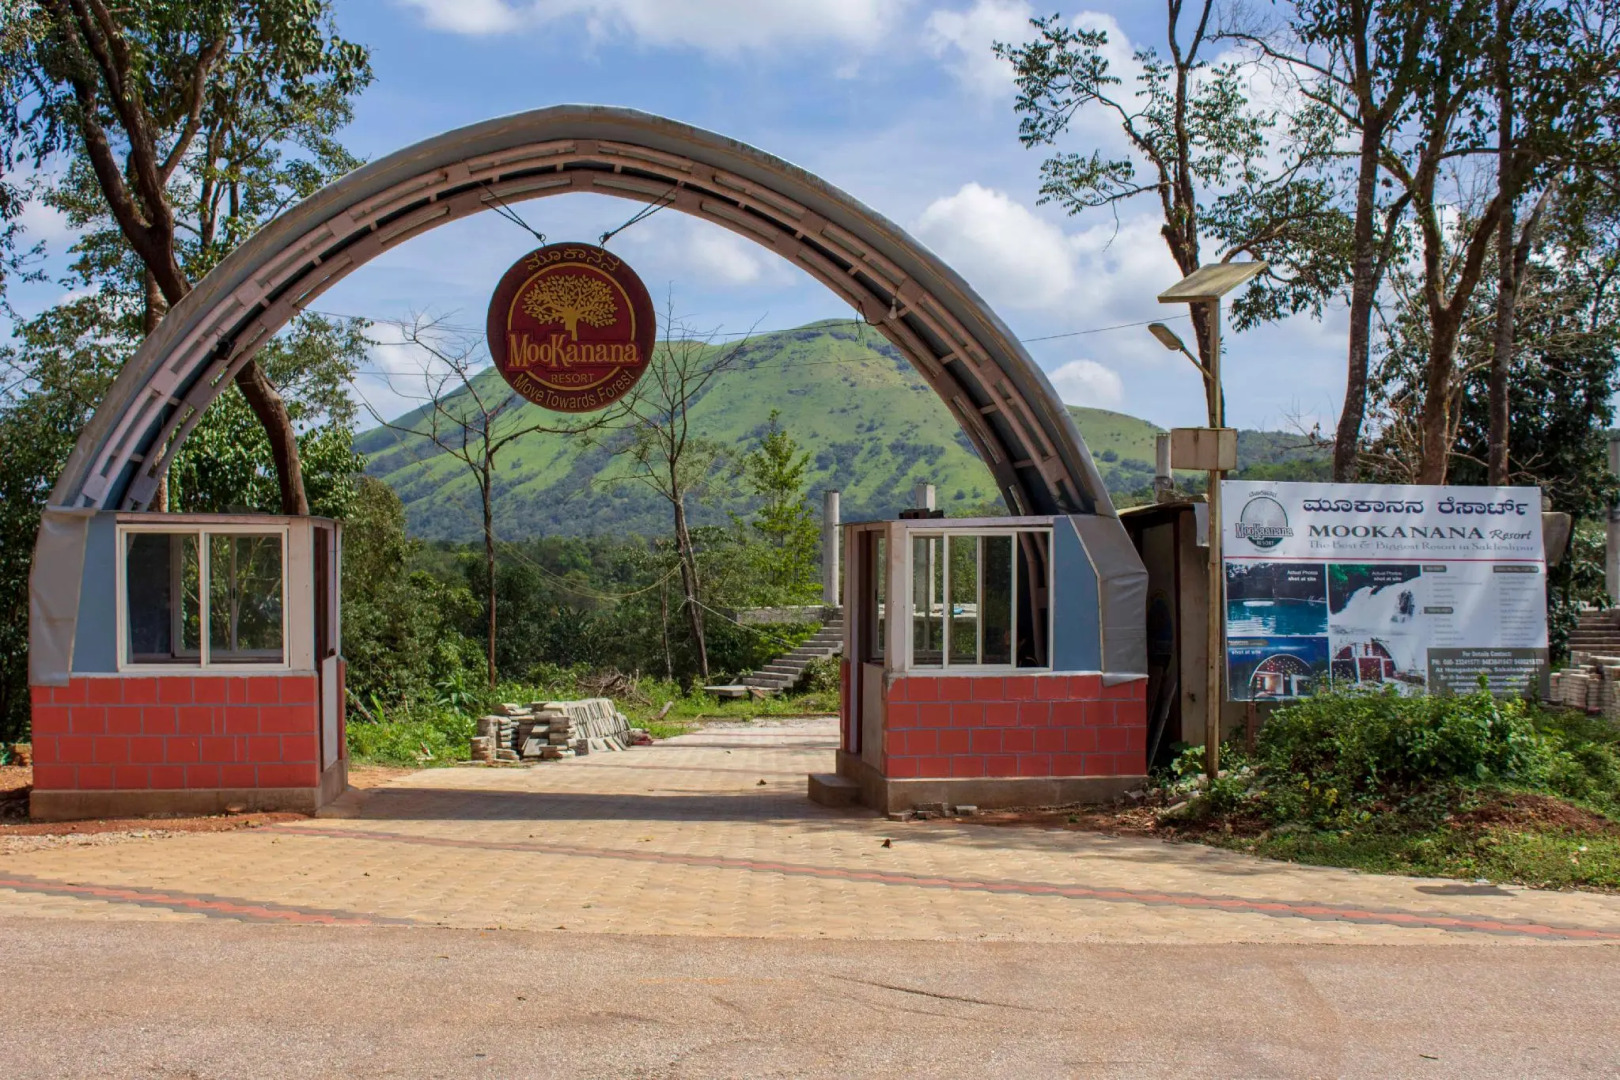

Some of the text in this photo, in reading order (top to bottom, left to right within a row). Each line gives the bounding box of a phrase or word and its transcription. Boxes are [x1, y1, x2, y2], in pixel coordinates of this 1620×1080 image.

[525, 248, 620, 271] ಮೂಕಾನನ
[508, 333, 639, 368] MooKanana
[551, 373, 595, 383] RESORT
[513, 370, 635, 409] Move Towards Forest
[1302, 496, 1529, 516] ಮೂಕಾನನ ರೆಸಾರ್ಟ್
[1308, 525, 1532, 541] MOOKANANA Resort
[1309, 540, 1330, 549] The
[1332, 540, 1356, 549] Best
[1376, 541, 1418, 551] Biggest
[1422, 541, 1456, 550] Resort
[1459, 542, 1469, 550] in
